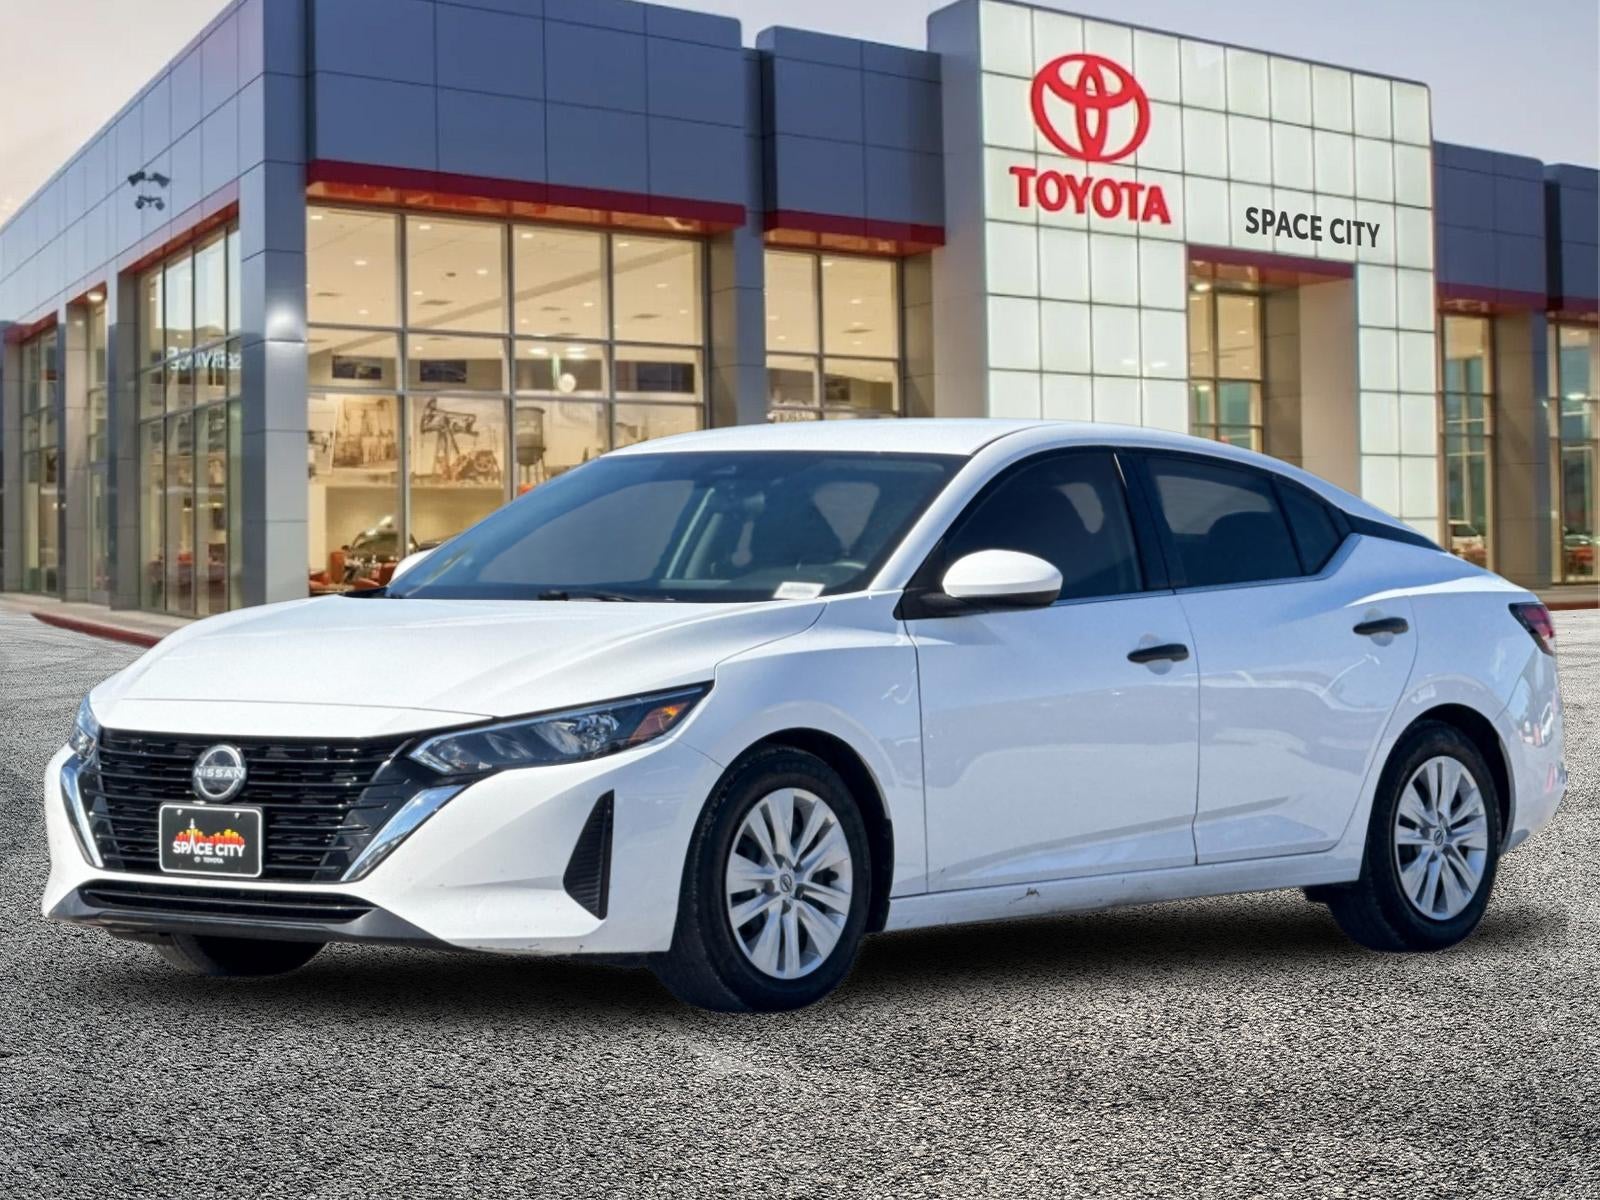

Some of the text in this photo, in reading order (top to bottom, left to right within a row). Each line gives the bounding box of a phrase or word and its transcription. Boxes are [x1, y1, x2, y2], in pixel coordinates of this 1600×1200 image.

[1009, 166, 1171, 224] TOYOTA
[1245, 206, 1380, 248] SPACE CITY
[194, 767, 245, 779] NISSAN
[172, 840, 246, 857] SPACE CITY
